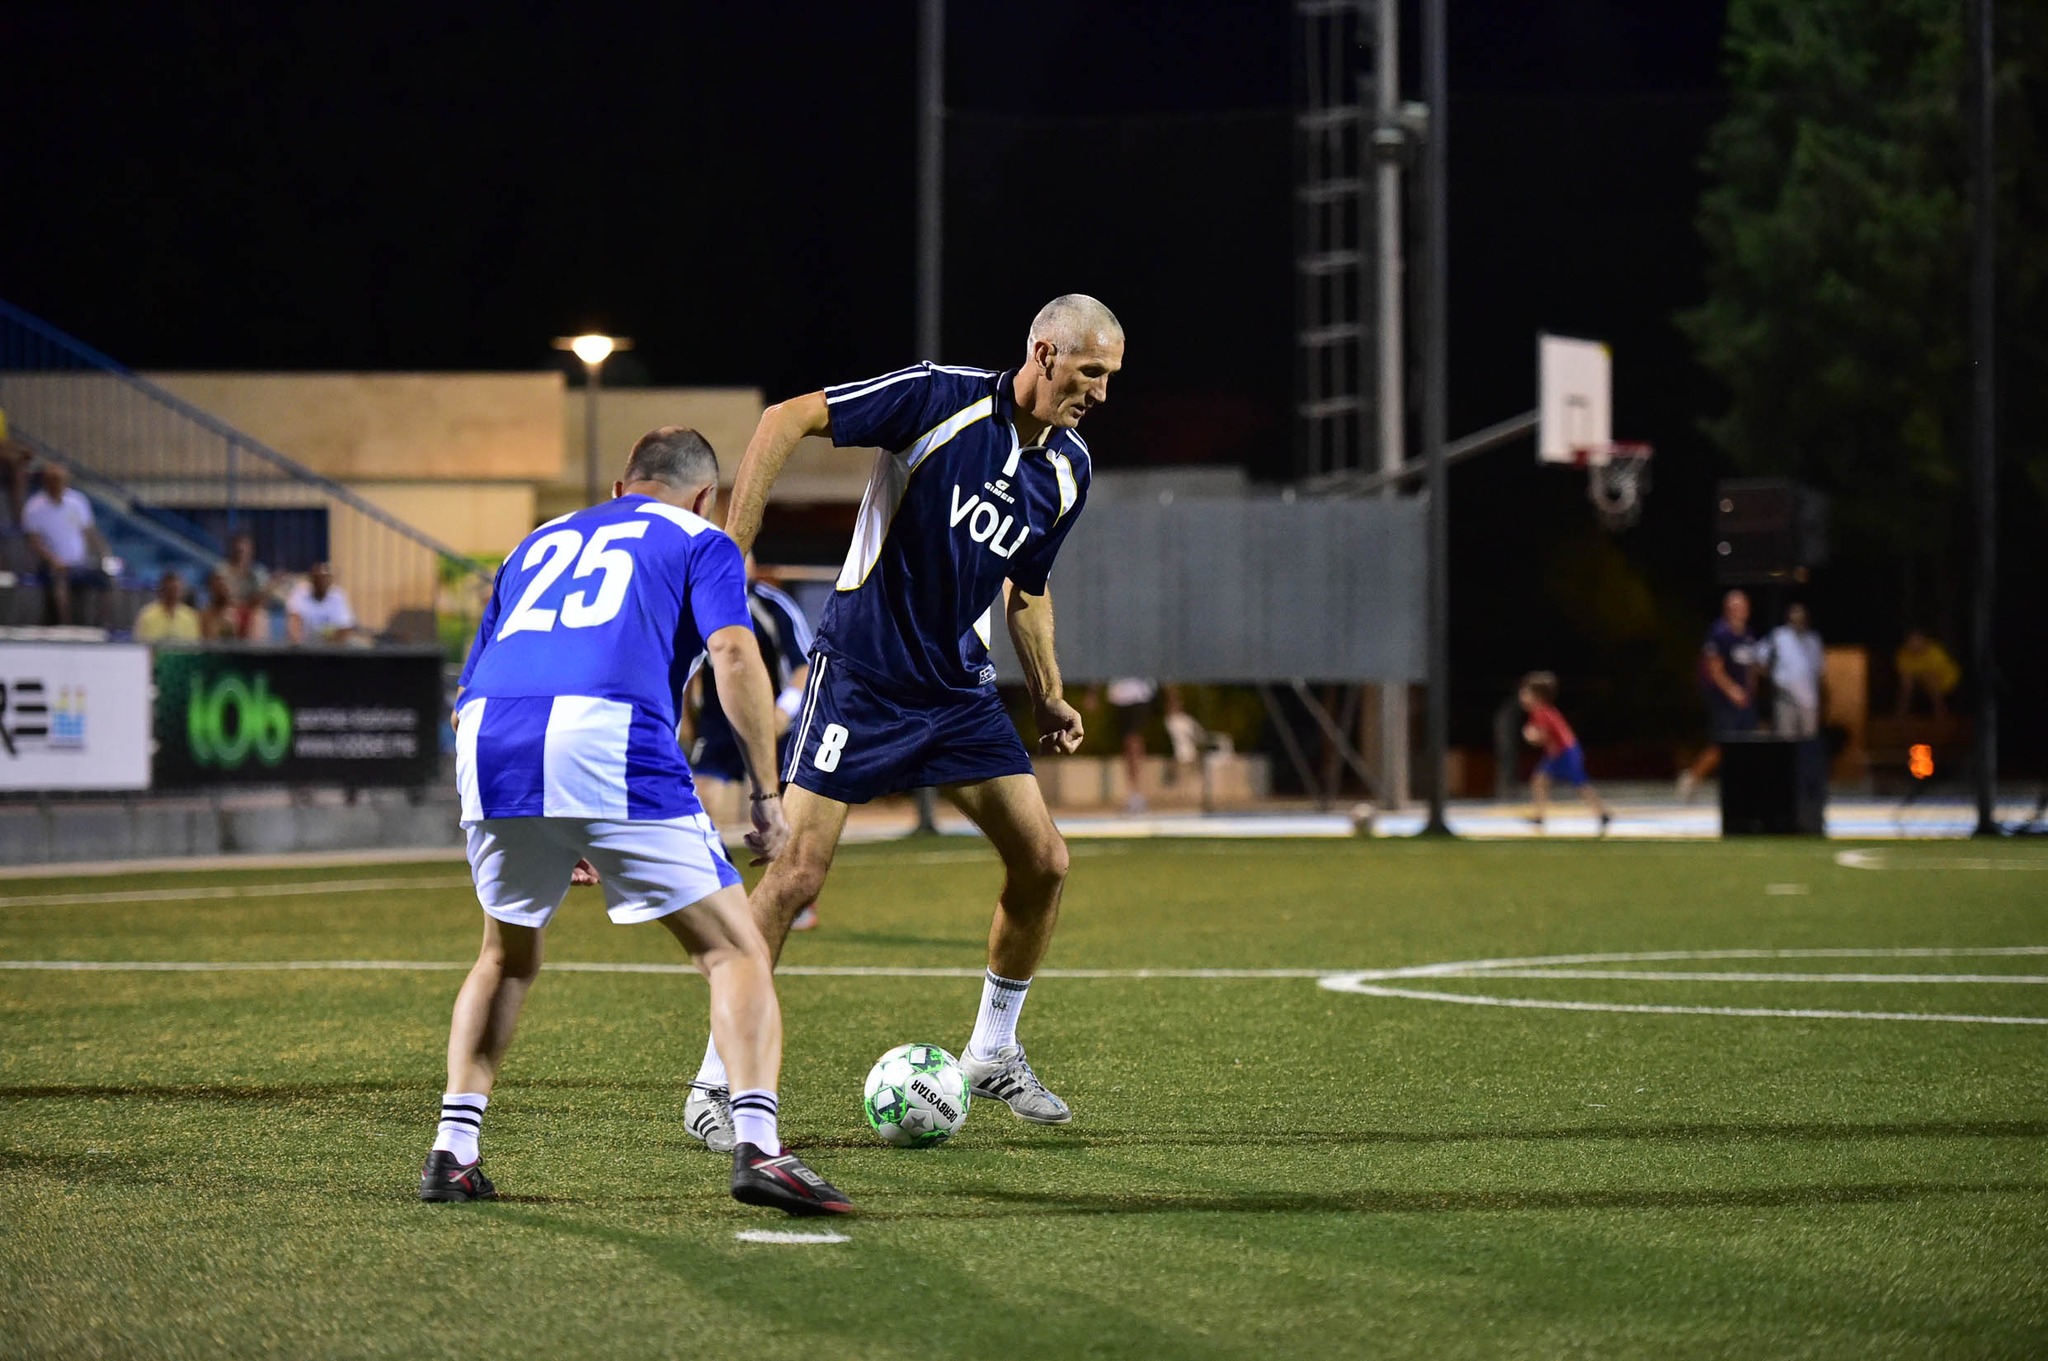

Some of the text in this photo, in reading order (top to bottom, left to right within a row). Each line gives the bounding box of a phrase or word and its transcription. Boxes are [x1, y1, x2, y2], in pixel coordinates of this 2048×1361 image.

[497, 520, 650, 643] 25
[813, 723, 849, 773] 8
[911, 1079, 958, 1123] DERBYSTAR
